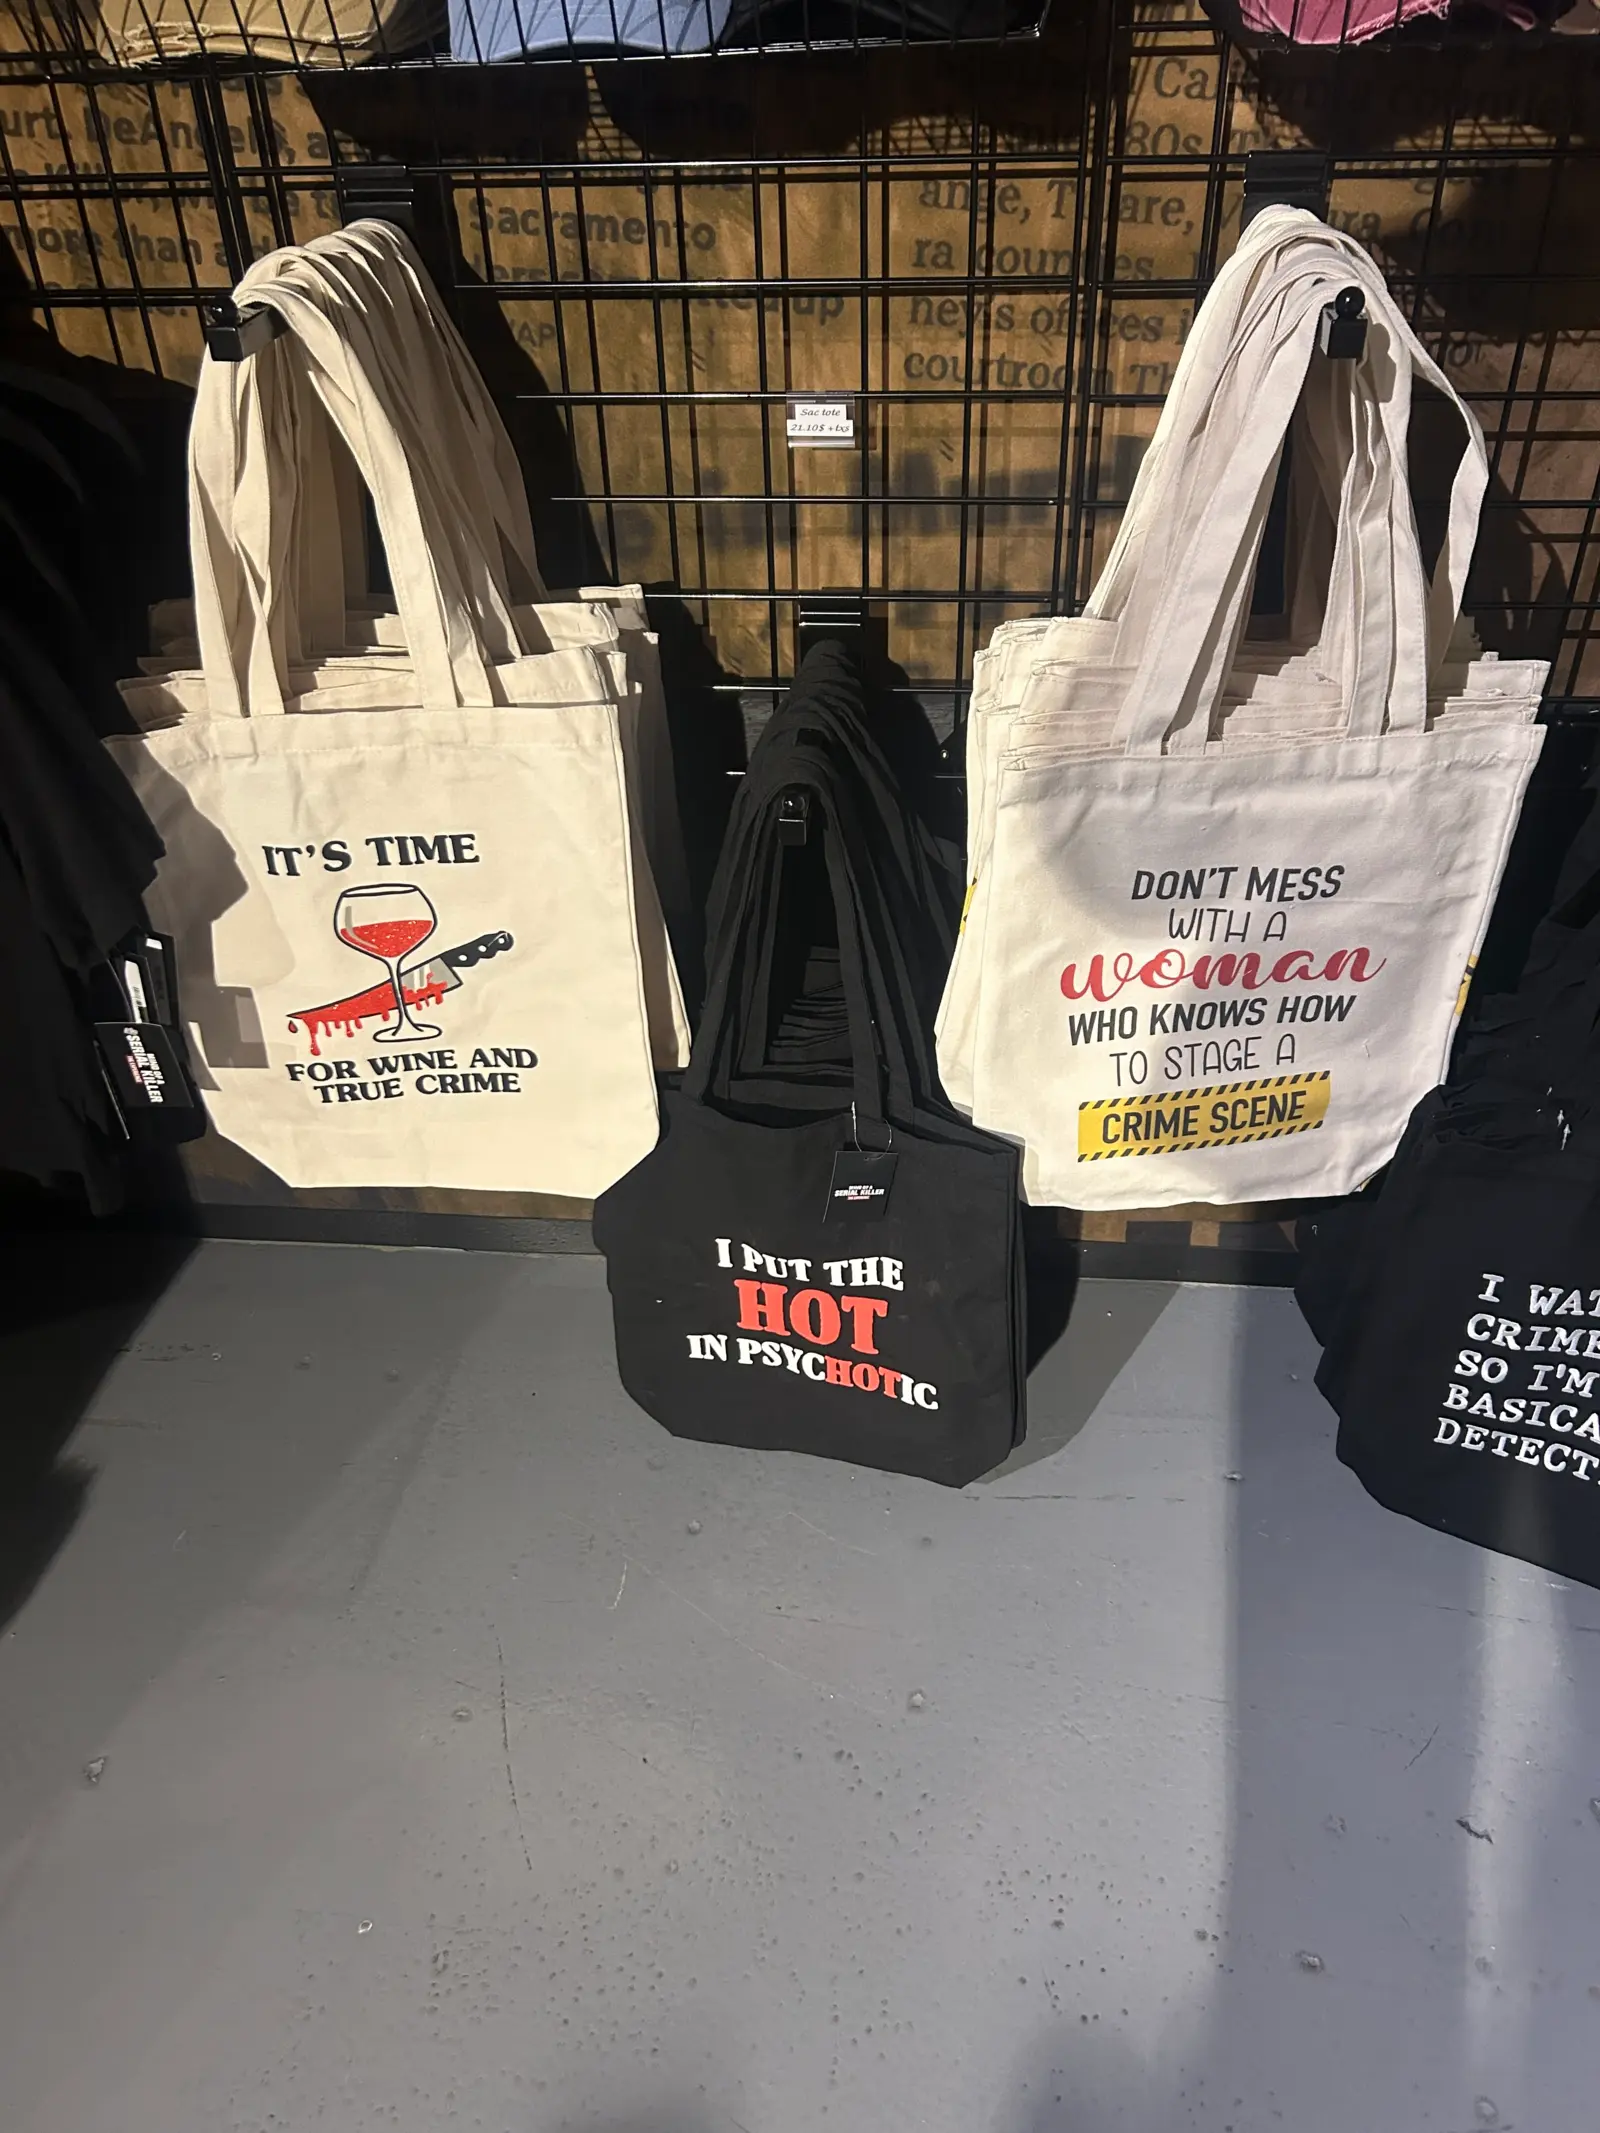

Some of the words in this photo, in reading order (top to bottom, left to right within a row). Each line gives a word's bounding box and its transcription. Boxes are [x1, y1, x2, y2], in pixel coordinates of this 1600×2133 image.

[469, 195, 717, 250] Sacrameno
[790, 424, 825, 432] 21.10$
[800, 408, 819, 416] Sac
[822, 408, 841, 416] tote
[261, 840, 353, 877] IT'S
[365, 833, 480, 867] TIME
[1131, 866, 1238, 900] DON'T
[1244, 864, 1345, 903] MESS
[1168, 907, 1251, 942] WITH
[1263, 911, 1287, 942] A
[1060, 947, 1387, 1002] woman
[1068, 1006, 1138, 1046] WHO
[1149, 997, 1268, 1036] KNOWS
[1276, 994, 1357, 1024] HOW
[126, 1035, 150, 1068] SERIAL
[141, 1070, 164, 1103] KILLER
[285, 1060, 360, 1082] FOR
[367, 1049, 458, 1076] WINE
[470, 1047, 538, 1069] AND
[1109, 1051, 1148, 1087] TO
[1164, 1036, 1262, 1081] STAGE
[1276, 1033, 1296, 1065] A
[313, 1078, 404, 1103] TRUE
[415, 1072, 522, 1095] CRIME
[1102, 1105, 1198, 1144] CRIME
[1209, 1090, 1307, 1135] SCENE
[714, 1238, 733, 1268] I
[741, 1243, 812, 1282] PUT
[823, 1256, 904, 1291] THE
[1478, 1272, 1505, 1303] I
[734, 1278, 889, 1355] HOT
[686, 1333, 728, 1361] IN
[736, 1337, 939, 1411] PSYCHOTIC
[1454, 1349, 1509, 1384] SO
[1527, 1363, 1600, 1399] I'M
[1442, 1383, 1600, 1446] BASICA
